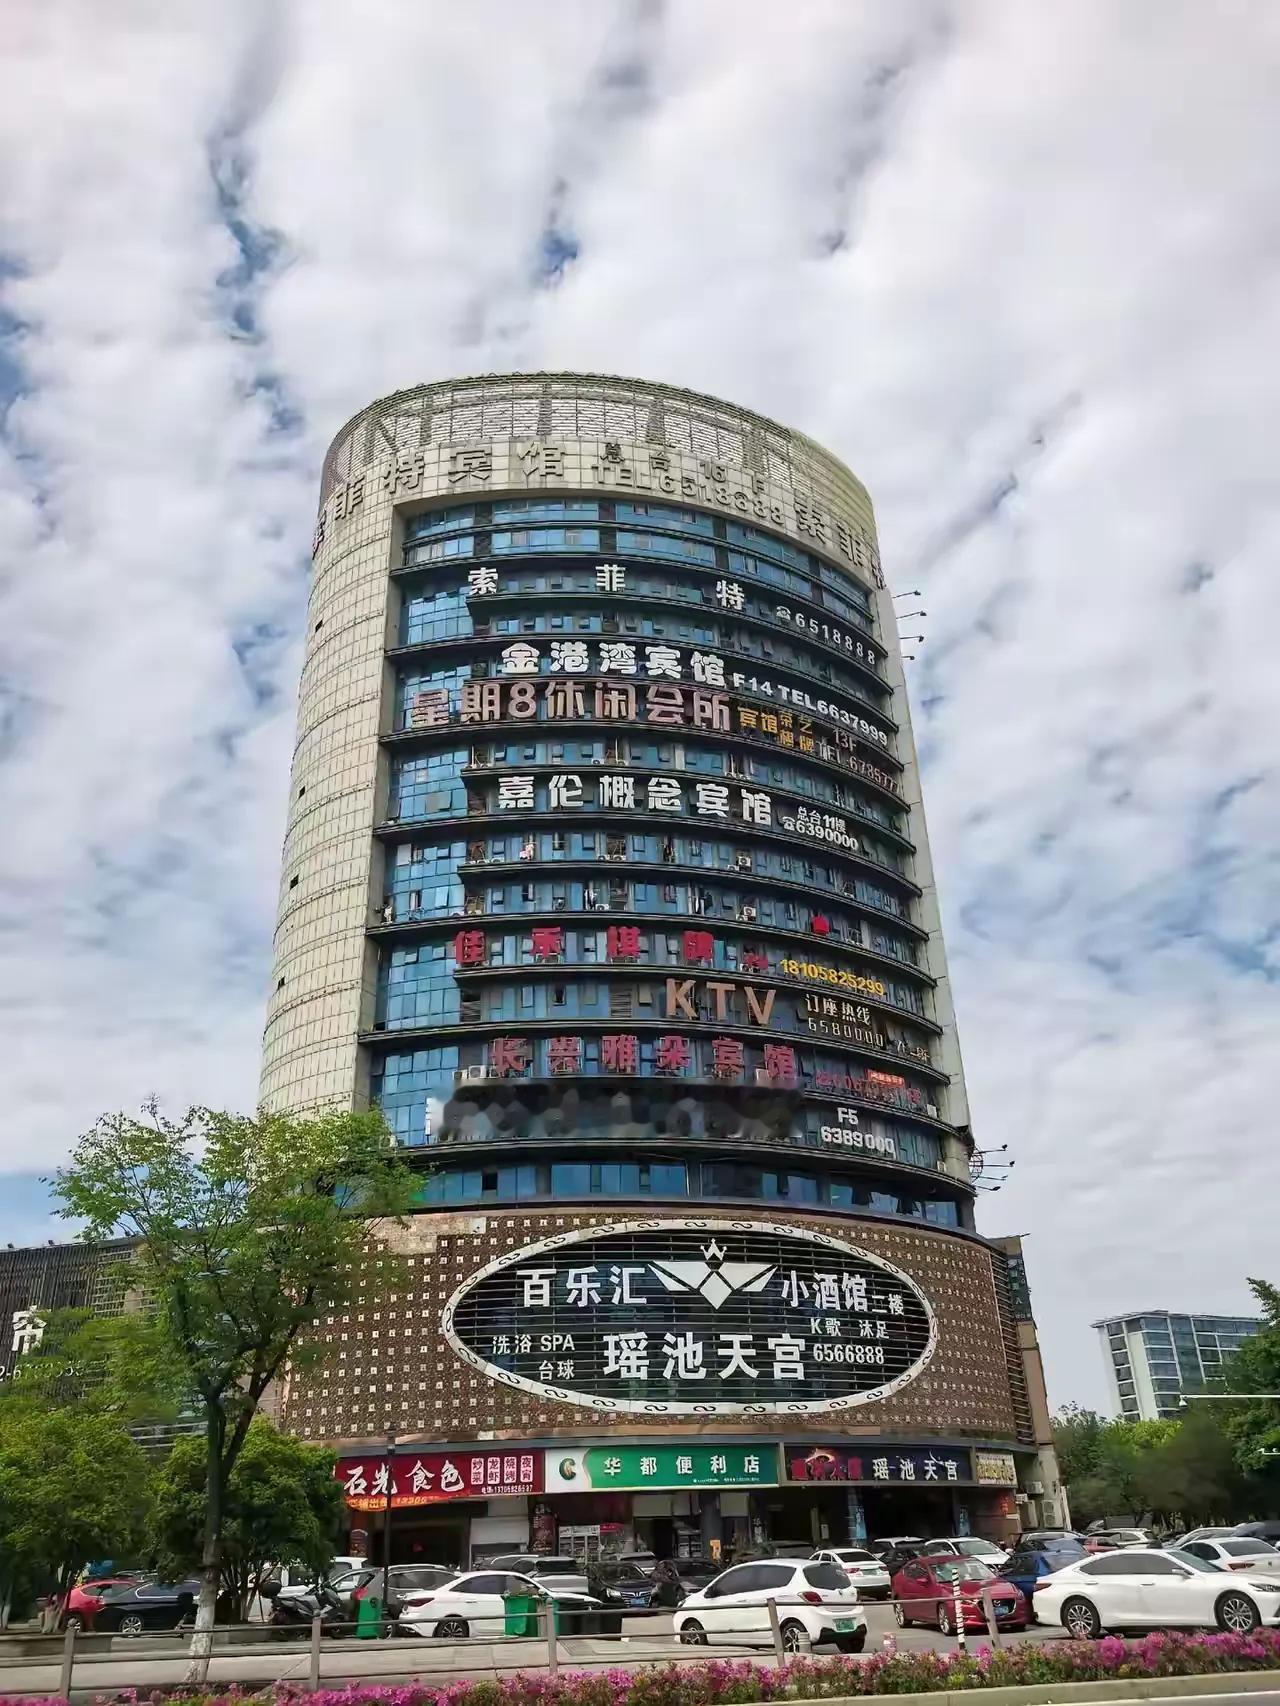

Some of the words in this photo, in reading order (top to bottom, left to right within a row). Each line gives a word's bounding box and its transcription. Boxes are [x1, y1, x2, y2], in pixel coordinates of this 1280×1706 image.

[467, 564, 745, 611] 索菲特
[795, 612, 876, 666] 6518888
[501, 641, 726, 688] 金港湾宾馆
[733, 672, 773, 697] F14
[410, 681, 731, 731] 星期8休闲会所
[738, 706, 778, 734] 宾馆
[498, 774, 772, 826] 嘉伦概念宾馆
[795, 820, 859, 851] 6390000
[780, 959, 886, 996] 18105825299
[665, 978, 776, 1026] KTV
[805, 994, 871, 1026] 订座热线
[808, 1017, 885, 1048] 6580000
[837, 1107, 858, 1126] F5
[517, 1265, 648, 1308] 百乐汇
[781, 1270, 868, 1312] 小酒馆
[492, 1334, 532, 1354] 洗浴
[540, 1334, 575, 1351] SPA
[810, 1318, 841, 1336] K歌
[858, 1319, 890, 1339] 沐足
[538, 1360, 575, 1381] 台球
[603, 1331, 806, 1380] 瑶池天宫
[813, 1343, 885, 1365] 6566888
[603, 1455, 760, 1476] 华都便利店
